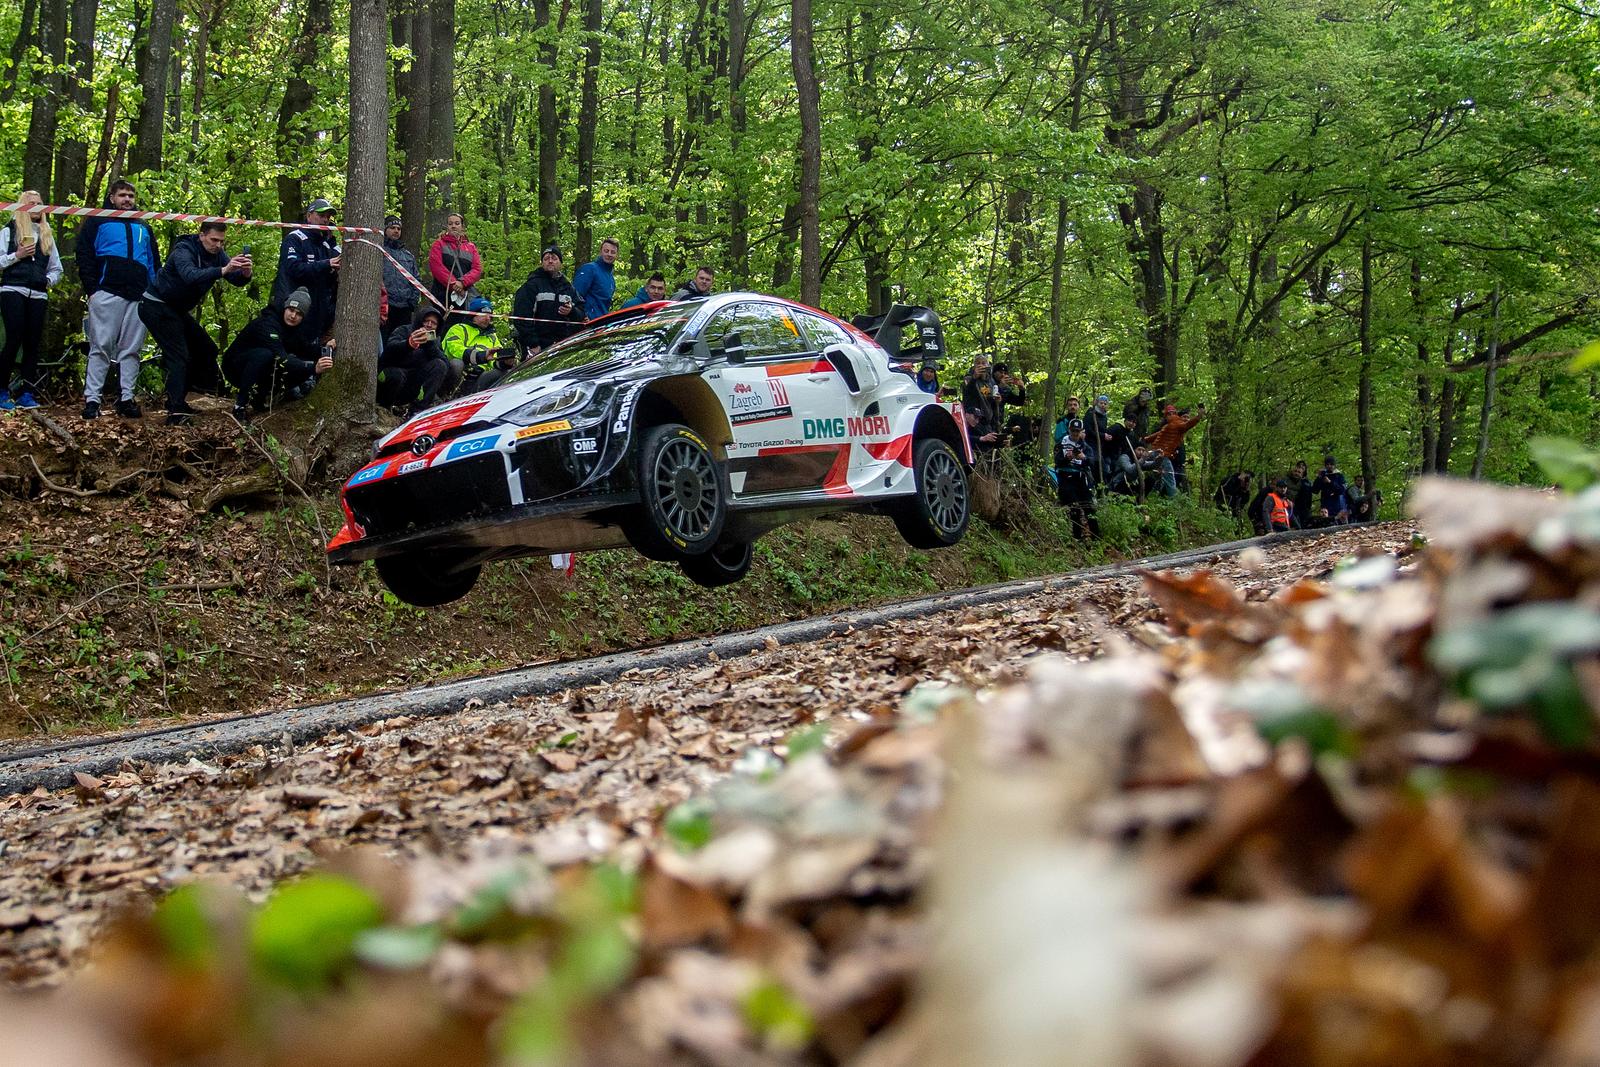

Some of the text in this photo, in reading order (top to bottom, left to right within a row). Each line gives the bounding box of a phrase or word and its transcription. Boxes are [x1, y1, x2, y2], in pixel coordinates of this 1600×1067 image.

[729, 391, 763, 411] Zagreb
[803, 415, 891, 440] DMG MORI
[573, 441, 597, 451] OMP
